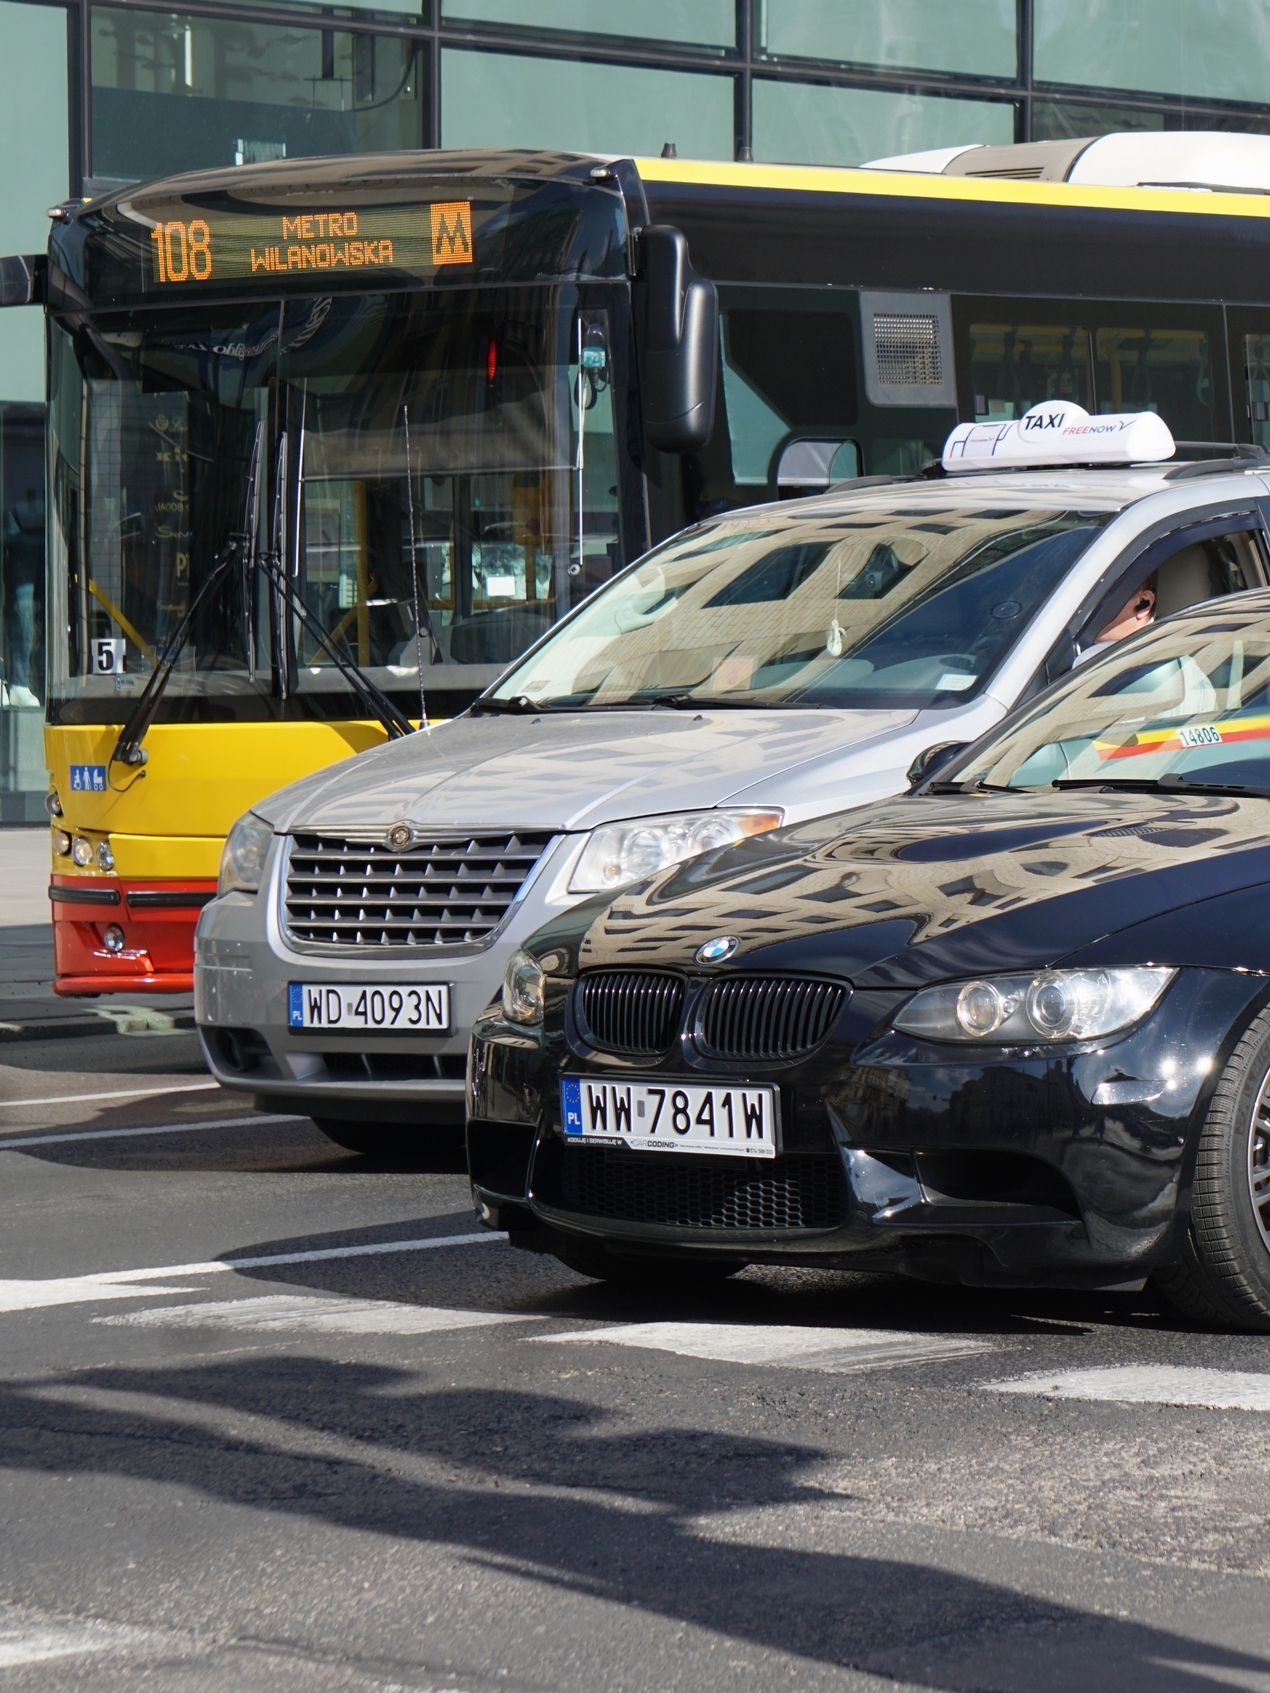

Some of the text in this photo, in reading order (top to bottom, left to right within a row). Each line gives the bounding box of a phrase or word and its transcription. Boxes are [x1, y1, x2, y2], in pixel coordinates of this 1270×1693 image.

[282, 211, 359, 240] METRO
[150, 219, 213, 282] 108
[250, 239, 394, 272] WILANOWSKA
[1024, 413, 1066, 431] TAXI
[98, 642, 114, 671] 5
[1180, 726, 1220, 746] 14806
[293, 1010, 303, 1021] PL
[308, 989, 443, 1026] WD 4093N
[567, 1112, 581, 1125] PL
[588, 1084, 764, 1139] WW 7841W
